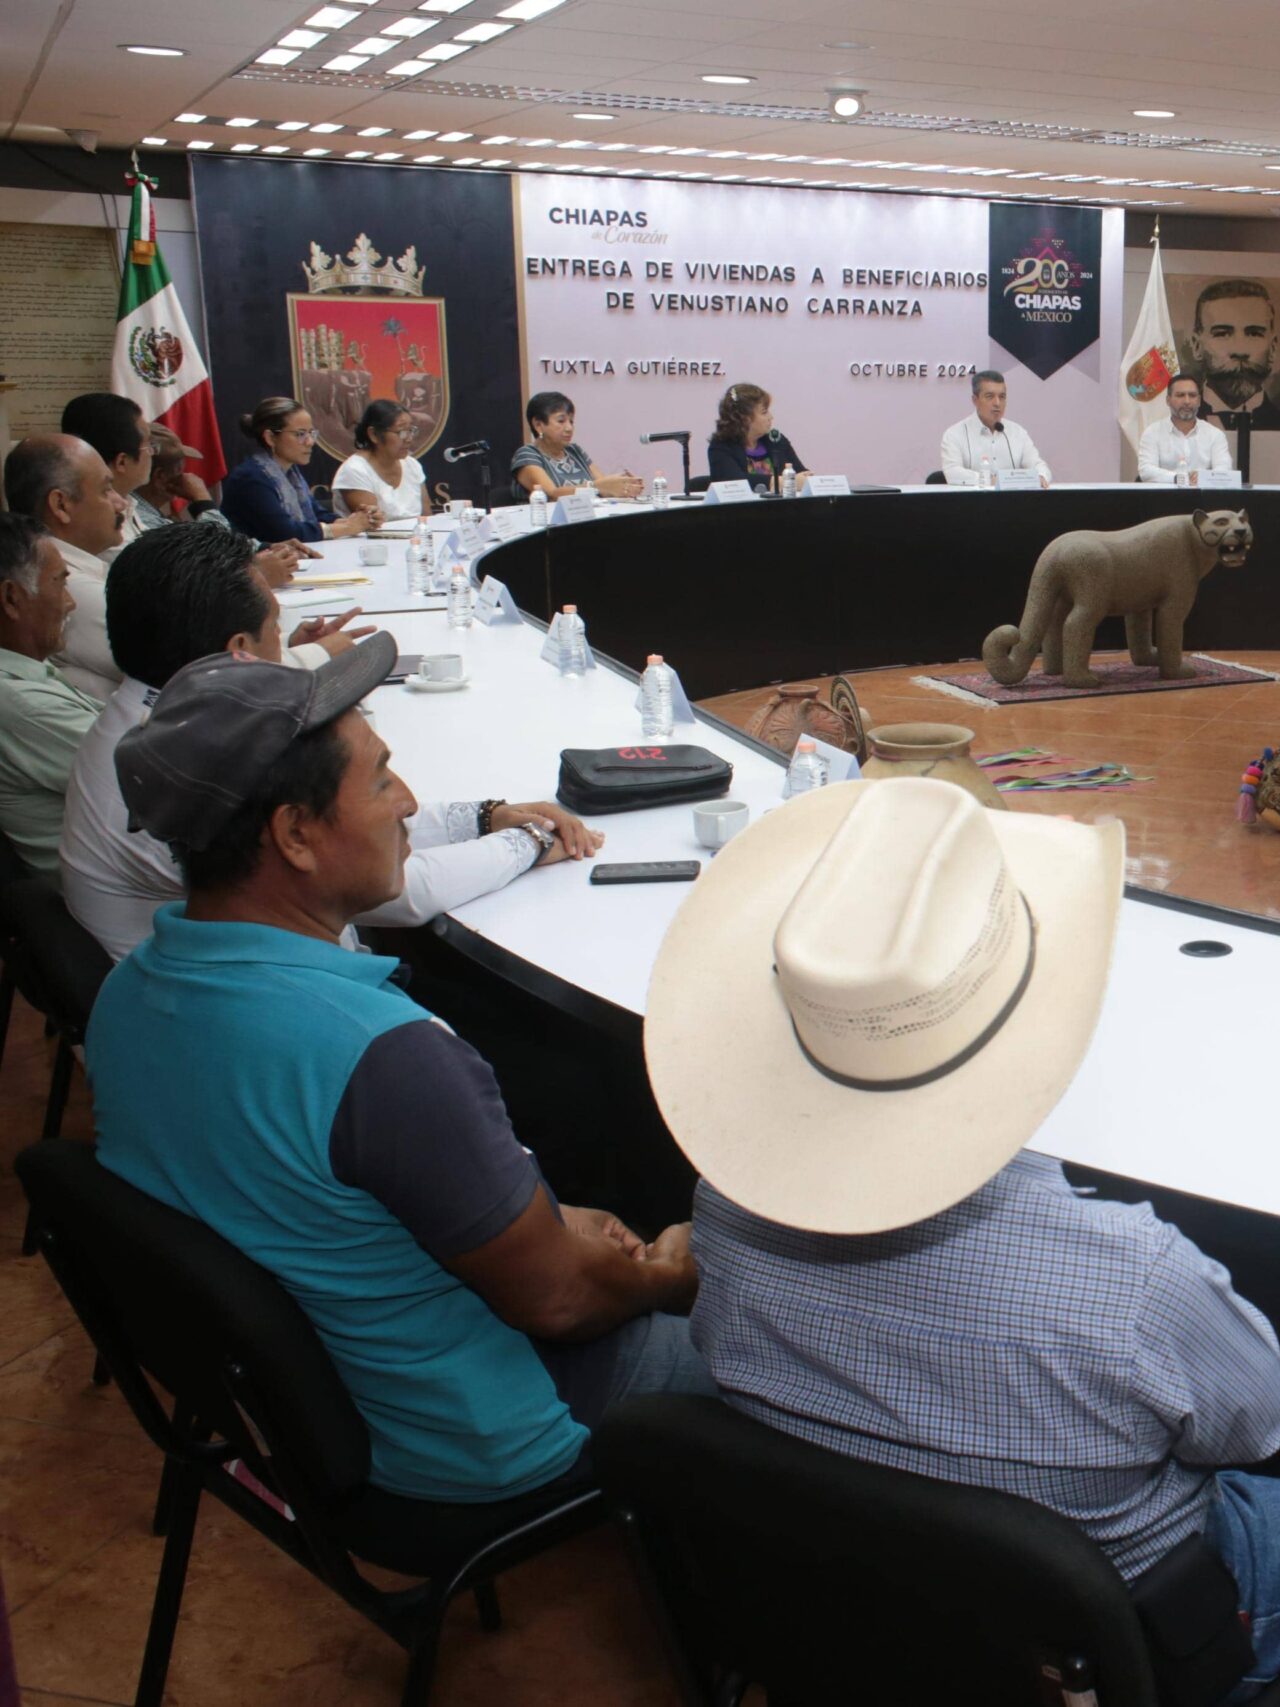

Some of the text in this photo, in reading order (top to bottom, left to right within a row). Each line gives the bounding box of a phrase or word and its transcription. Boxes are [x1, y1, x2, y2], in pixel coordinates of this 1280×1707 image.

[548, 207, 648, 228] CHIAPAS
[604, 225, 669, 245] Corazón
[526, 257, 988, 288] ENTREGA DE VIVIENDAS A BENEFICIARIOS
[606, 292, 923, 317] DE VENUSTIANO CARRANZA
[1014, 294, 1082, 310] CHIAPAS
[1026, 309, 1072, 323] MÉXICO
[540, 356, 726, 376] TUXTLA GUTIÉRREZ.
[850, 363, 977, 378] OCTUBRE 2024
